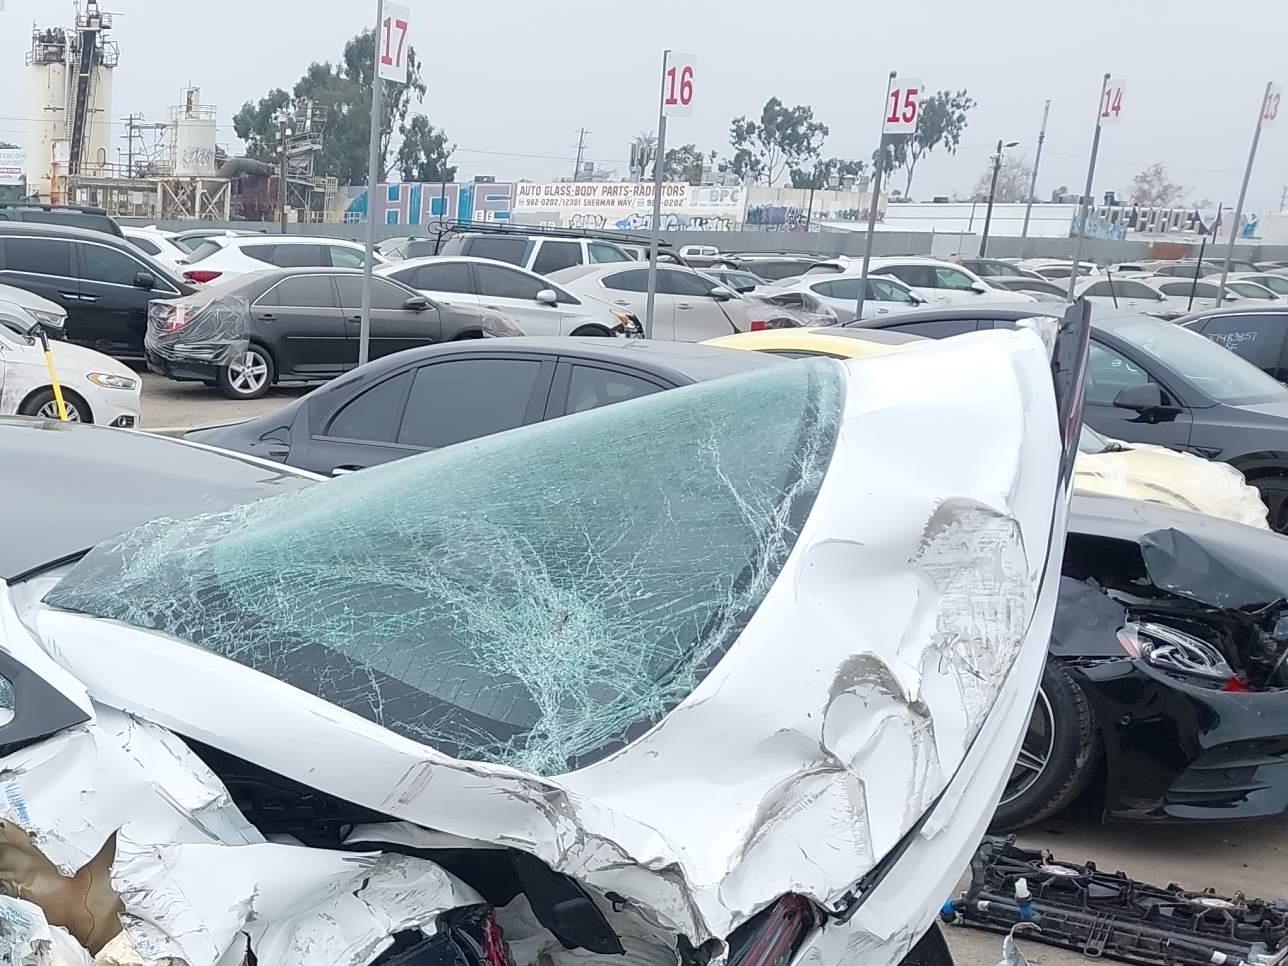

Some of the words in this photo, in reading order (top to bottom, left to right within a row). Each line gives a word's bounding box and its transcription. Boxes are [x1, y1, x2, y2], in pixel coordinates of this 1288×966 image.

[381, 16, 408, 68] 17
[665, 66, 694, 105] 16
[887, 88, 919, 123] 15
[1101, 87, 1122, 117] 14
[1263, 93, 1281, 120] 13
[520, 185, 541, 196] AUTO
[710, 189, 740, 203] BPC
